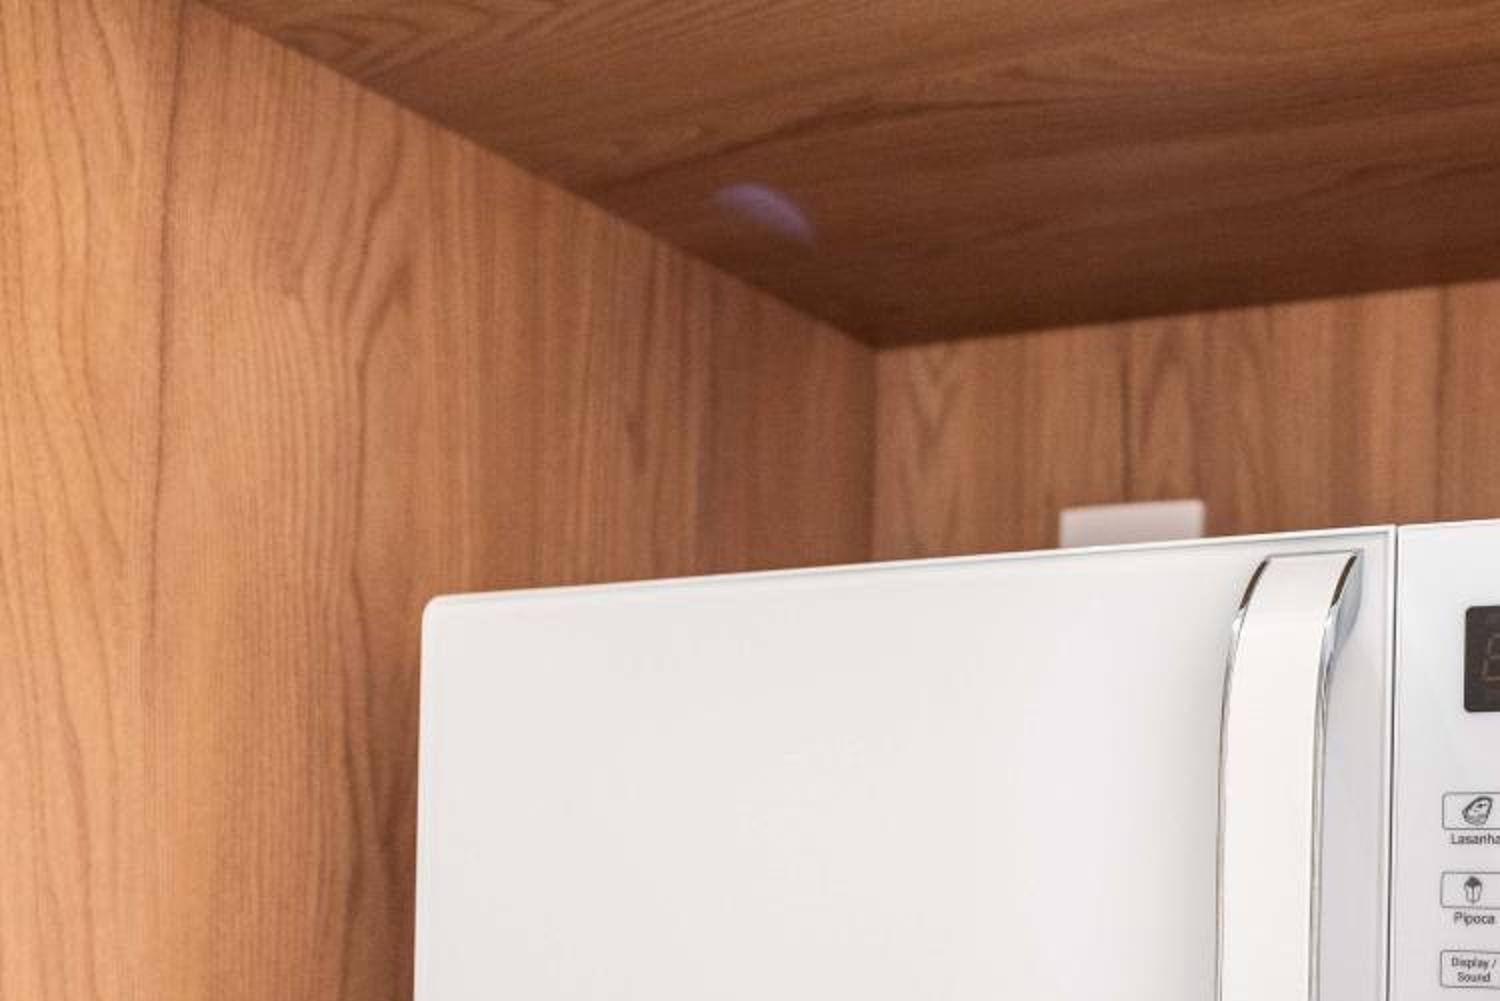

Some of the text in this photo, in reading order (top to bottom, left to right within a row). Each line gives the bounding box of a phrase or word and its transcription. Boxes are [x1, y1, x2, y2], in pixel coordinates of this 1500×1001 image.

[1453, 912, 1496, 926] Pipoca
[1450, 956, 1488, 971] Display
[1457, 971, 1491, 984] Sound
